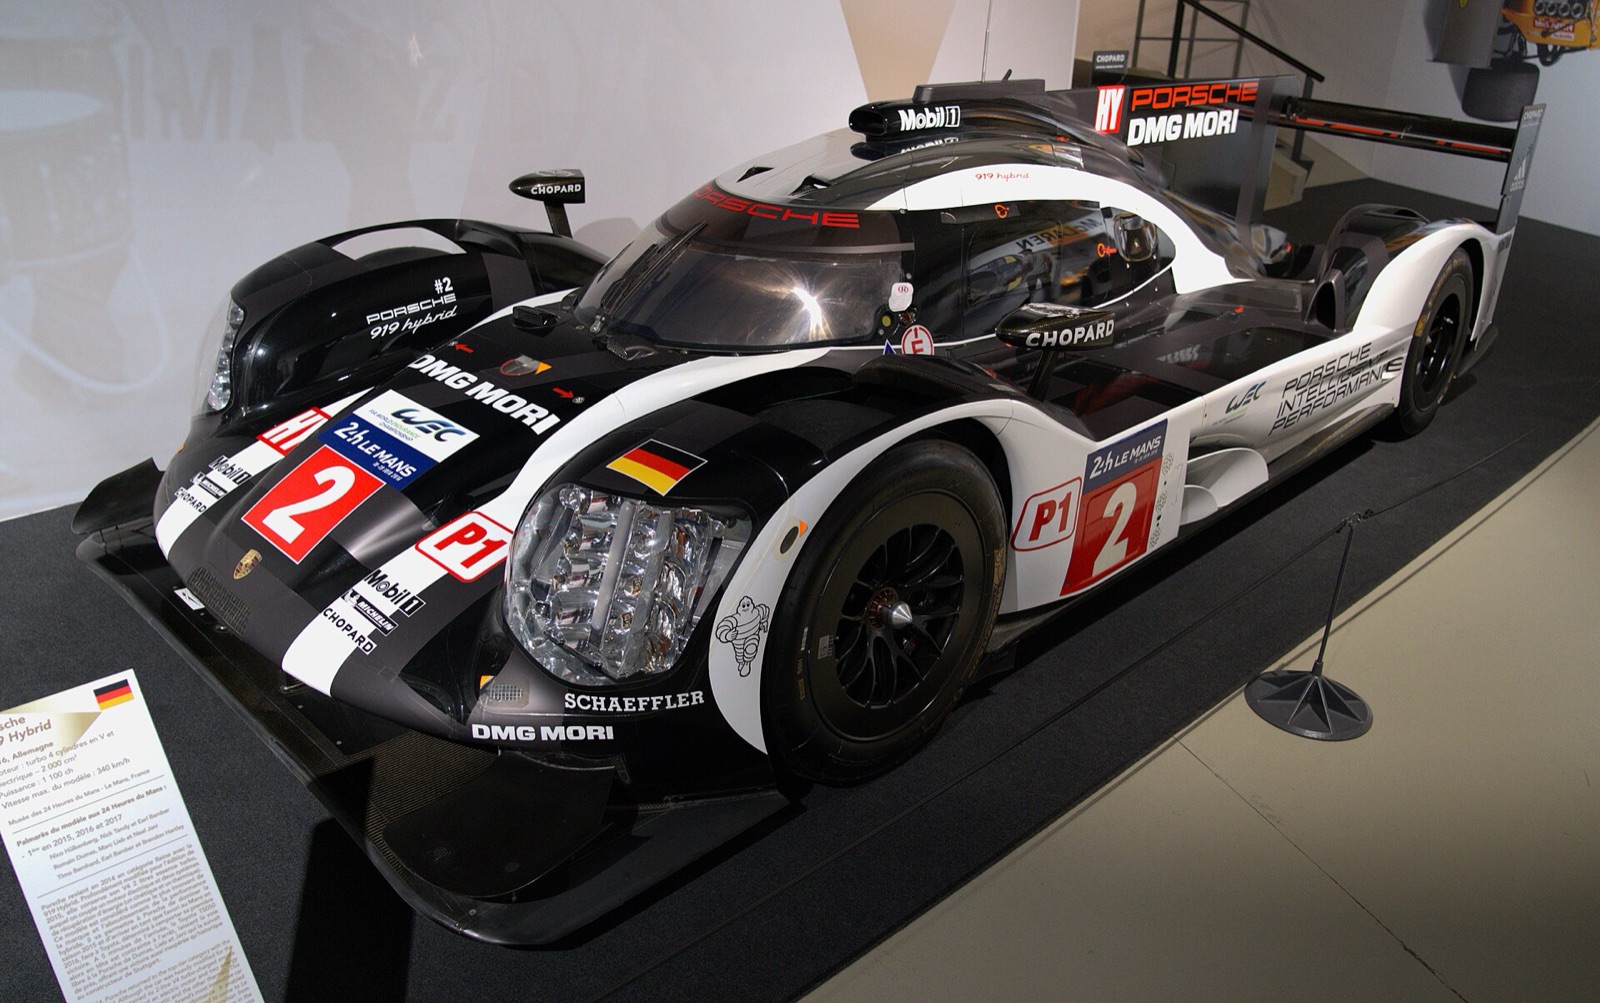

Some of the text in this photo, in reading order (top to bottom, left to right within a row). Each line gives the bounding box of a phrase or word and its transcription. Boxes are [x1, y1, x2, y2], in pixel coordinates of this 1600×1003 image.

[1096, 54, 1125, 63] CHOPARD
[1095, 88, 1124, 131] HY
[1131, 82, 1258, 112] PORSCHE
[898, 107, 945, 131] Mobil
[1127, 109, 1239, 146] DMG MORI
[531, 184, 581, 194] CHOPARD
[996, 172, 1029, 182] hybrid
[694, 185, 859, 228] ORSCHE
[434, 276, 454, 294] #2
[366, 293, 457, 325] PORSCHE
[370, 305, 458, 339] 919 hybrid
[1026, 319, 1115, 347] CHOPARD
[1277, 351, 1389, 418] INTELLIGENT
[1282, 342, 1372, 398] PORSCHE
[408, 354, 560, 435] DMG MORI
[1226, 380, 1266, 414] WEC
[390, 408, 466, 442] WEC
[212, 456, 244, 480] Mobil
[357, 440, 381, 455] LE
[373, 450, 417, 477] MANS
[1114, 450, 1130, 468] LE
[1130, 436, 1162, 460] MANS
[176, 488, 207, 512] CHOPARD
[262, 466, 356, 544] 2
[1029, 491, 1072, 541] P1
[433, 522, 508, 569] P1
[1092, 481, 1137, 577] 2
[364, 569, 411, 606] Mobil
[323, 608, 374, 653] CHOPARD
[358, 600, 394, 630] MICHELIN
[564, 690, 704, 712] SCHAEFFLER
[8, 719, 52, 742] Hybrid
[472, 724, 614, 741] DMG MORI
[12, 742, 54, 760] Allemagne
[25, 755, 48, 767] turbo
[55, 741, 88, 756] cylindres
[106, 730, 115, 738] et
[40, 765, 47, 773] 2
[47, 759, 63, 770] 000
[63, 753, 77, 765] cm³
[2, 757, 131, 810] Vitesse max. du modèle 340 km/h
[48, 770, 64, 781] 100
[64, 767, 74, 775] ch
[16, 786, 163, 847] Palmarès du modèle aux 24 Heures du Mans
[41, 843, 52, 852] en
[52, 833, 75, 847] 2015,
[75, 825, 95, 838] 2016
[95, 822, 104, 830] et
[104, 813, 122, 827] 2017
